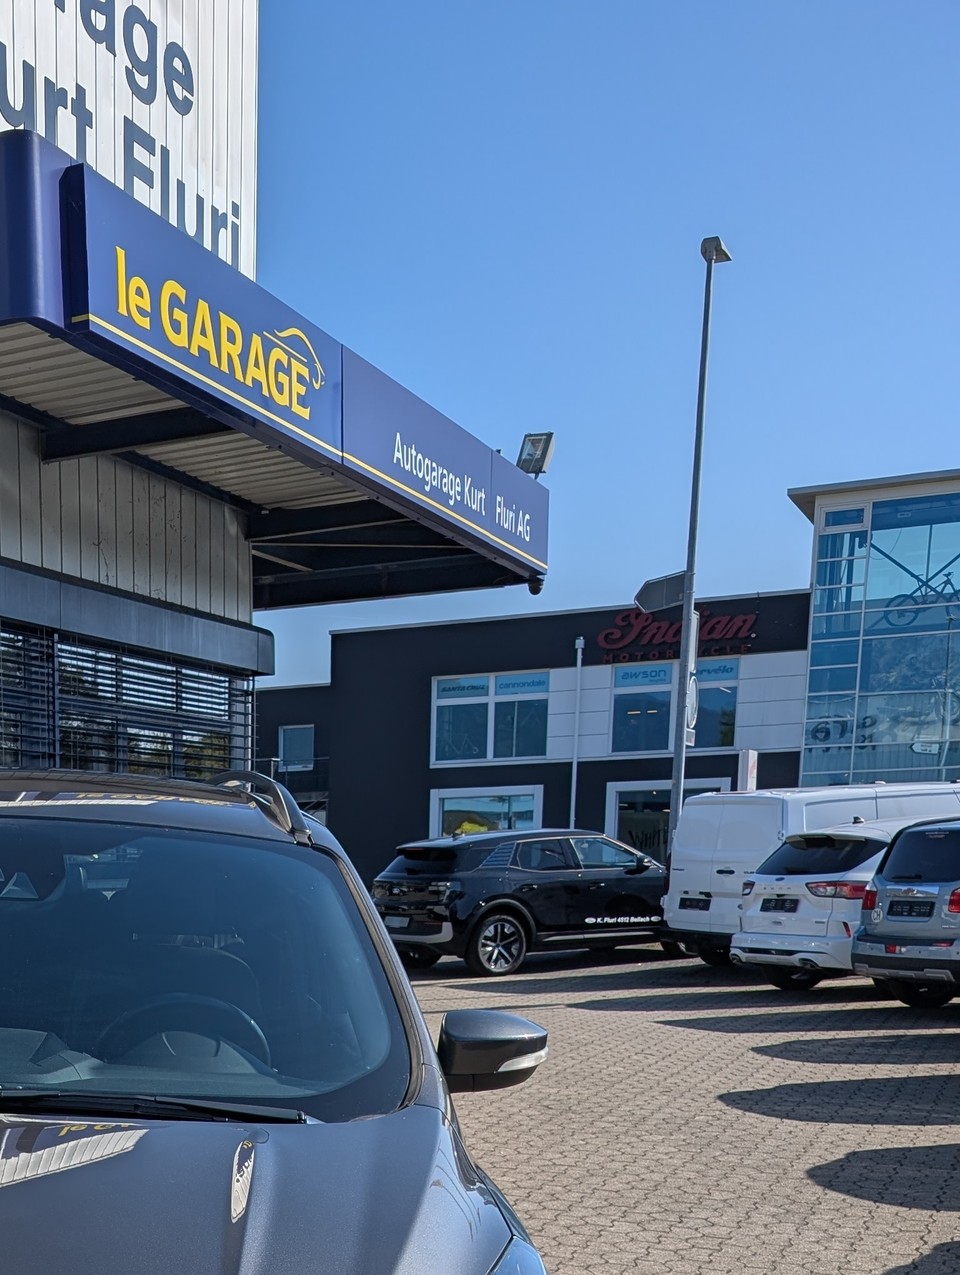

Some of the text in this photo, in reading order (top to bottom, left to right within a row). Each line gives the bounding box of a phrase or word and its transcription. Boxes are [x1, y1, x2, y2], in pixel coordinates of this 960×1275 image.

[54, 0, 194, 116] age
[124, 115, 240, 273] Fluri
[115, 246, 311, 421] le GARAGE
[393, 432, 531, 542] Autogarage Kurt Fluri AG
[498, 679, 546, 690] cannondale
